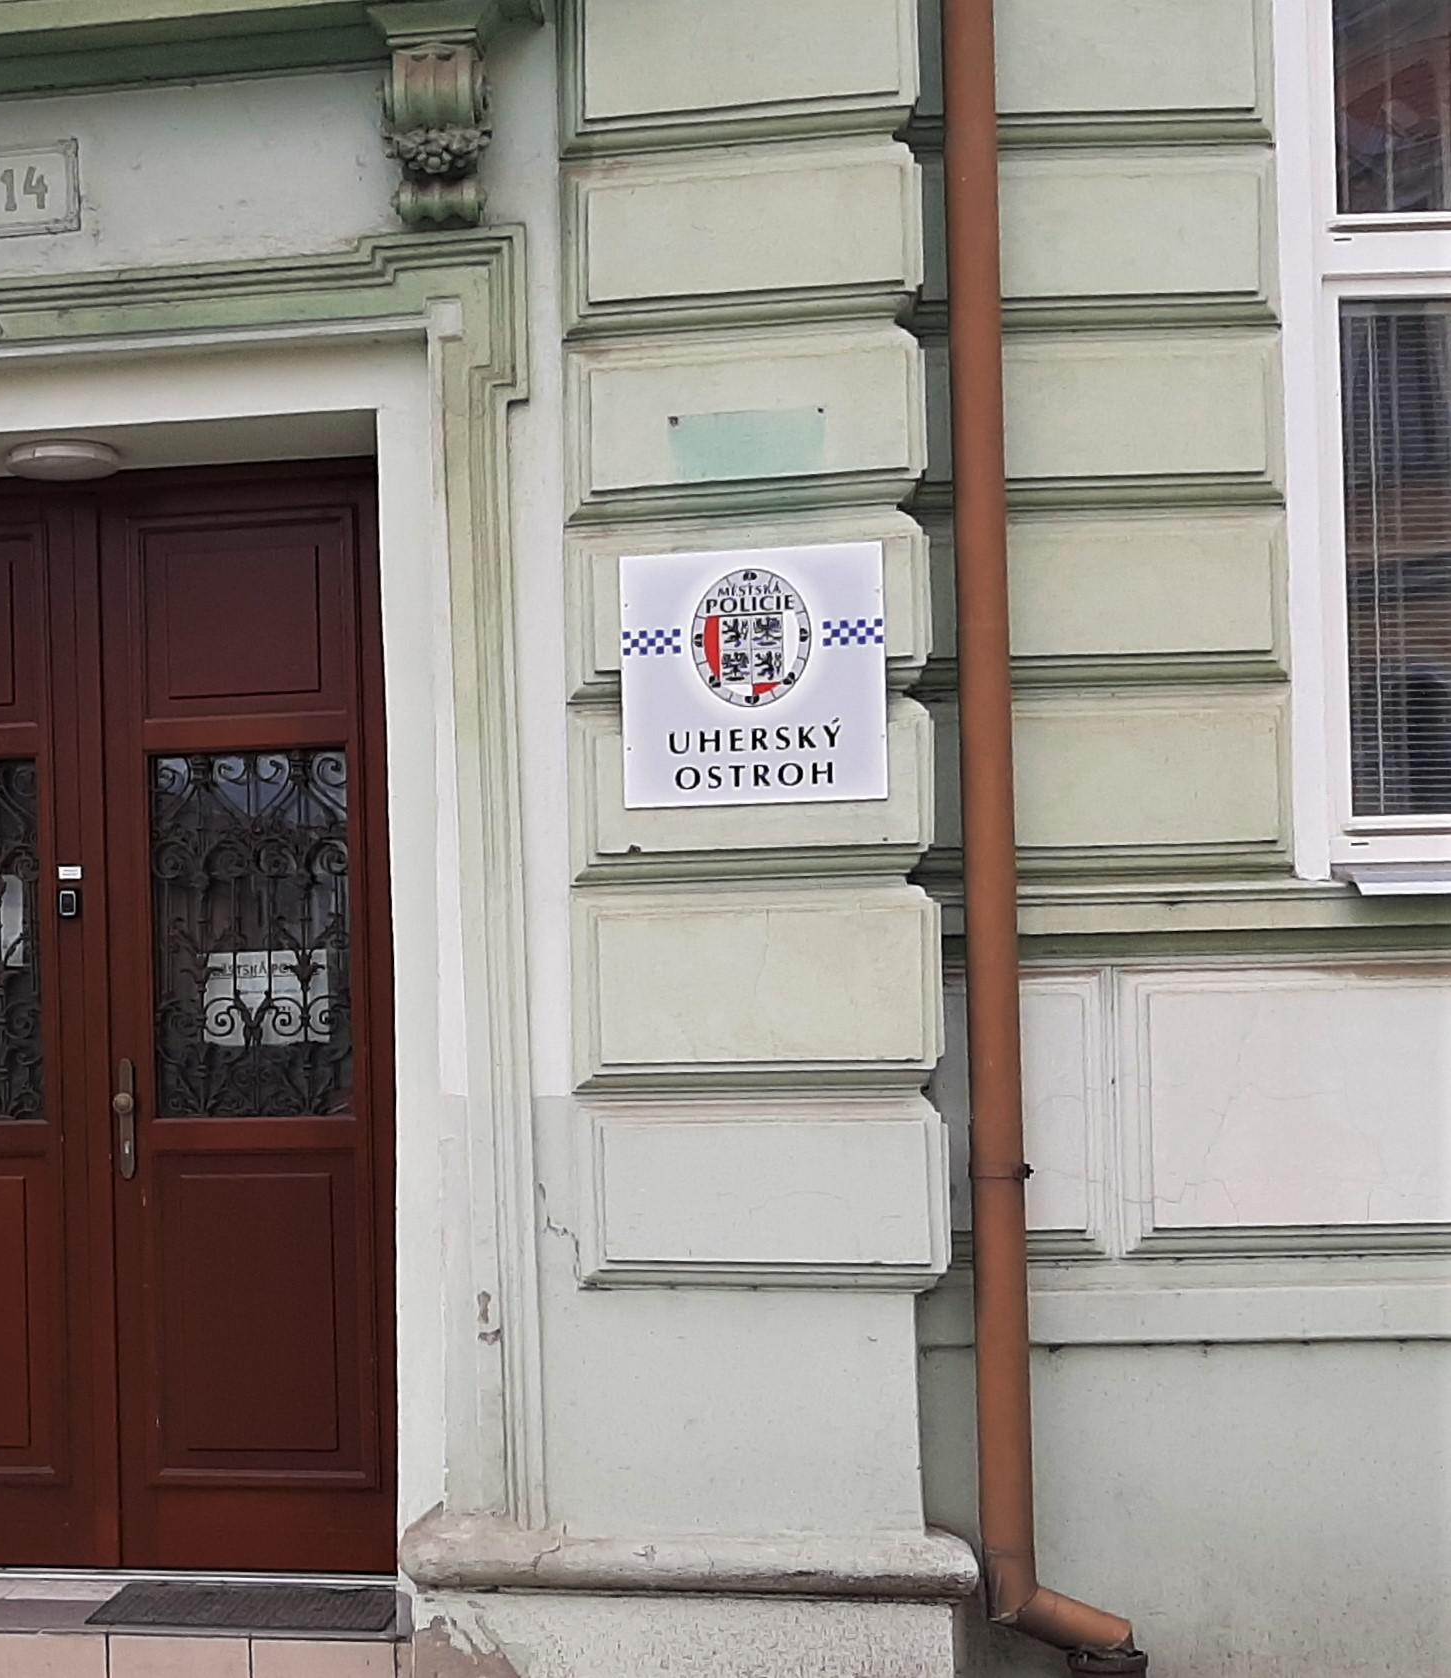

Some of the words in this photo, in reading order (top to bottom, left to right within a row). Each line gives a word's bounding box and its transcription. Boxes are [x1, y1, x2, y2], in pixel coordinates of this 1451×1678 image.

[0, 166, 48, 211] 14
[706, 595, 794, 613] POLICIE
[669, 717, 841, 754] UHERSKÝ
[675, 762, 835, 789] OSTROH
